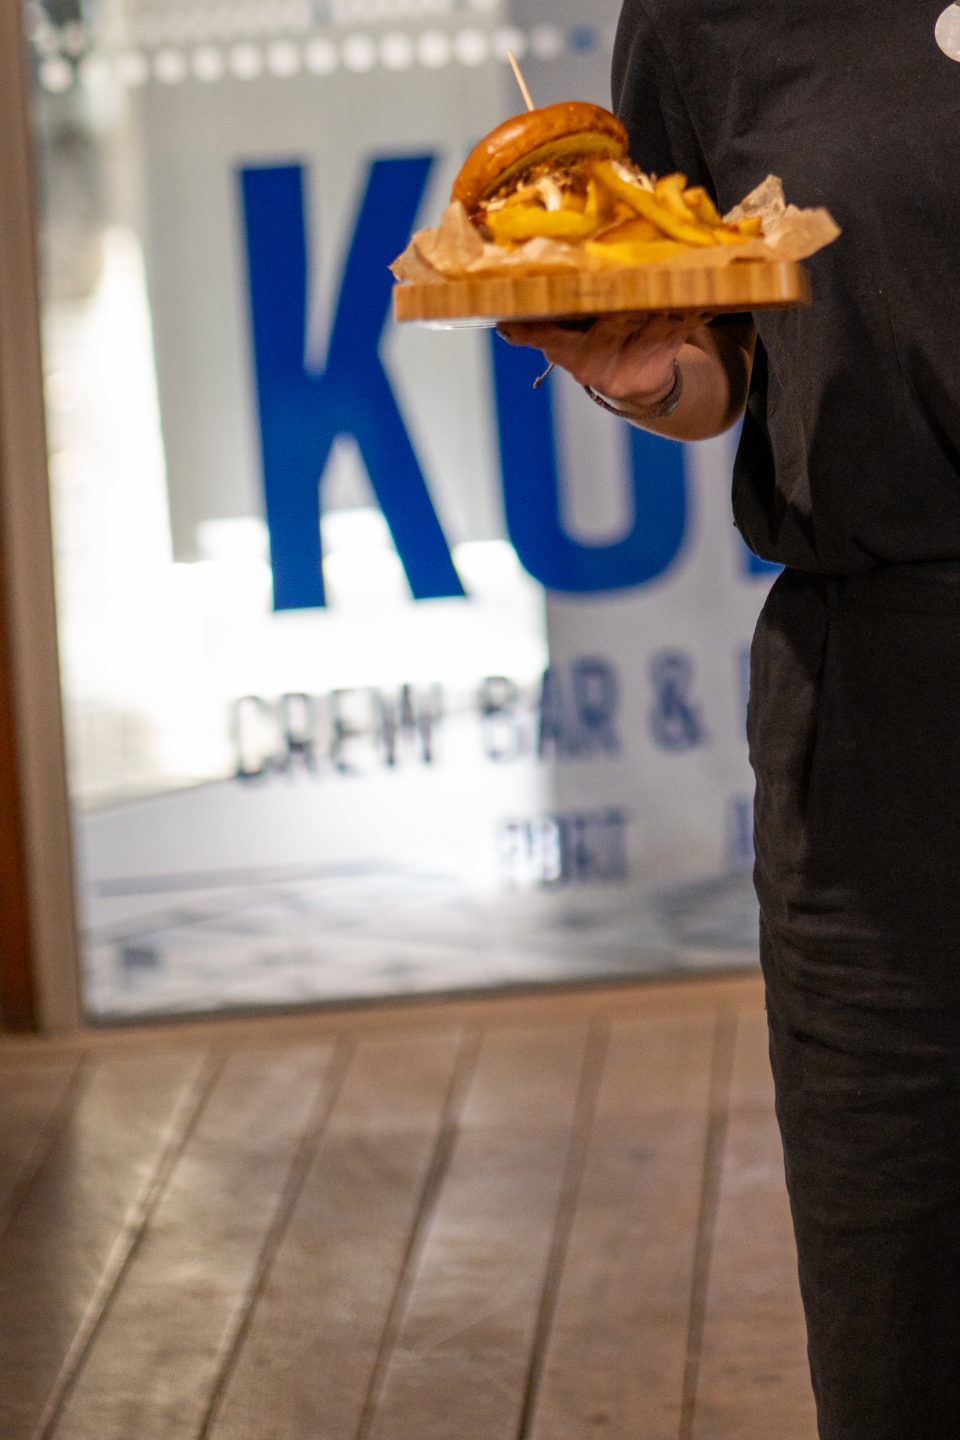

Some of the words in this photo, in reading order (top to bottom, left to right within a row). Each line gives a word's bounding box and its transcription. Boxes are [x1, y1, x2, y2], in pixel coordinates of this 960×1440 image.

[229, 681, 442, 779] CREW
[480, 654, 621, 762] BAR
[650, 646, 706, 752] &
